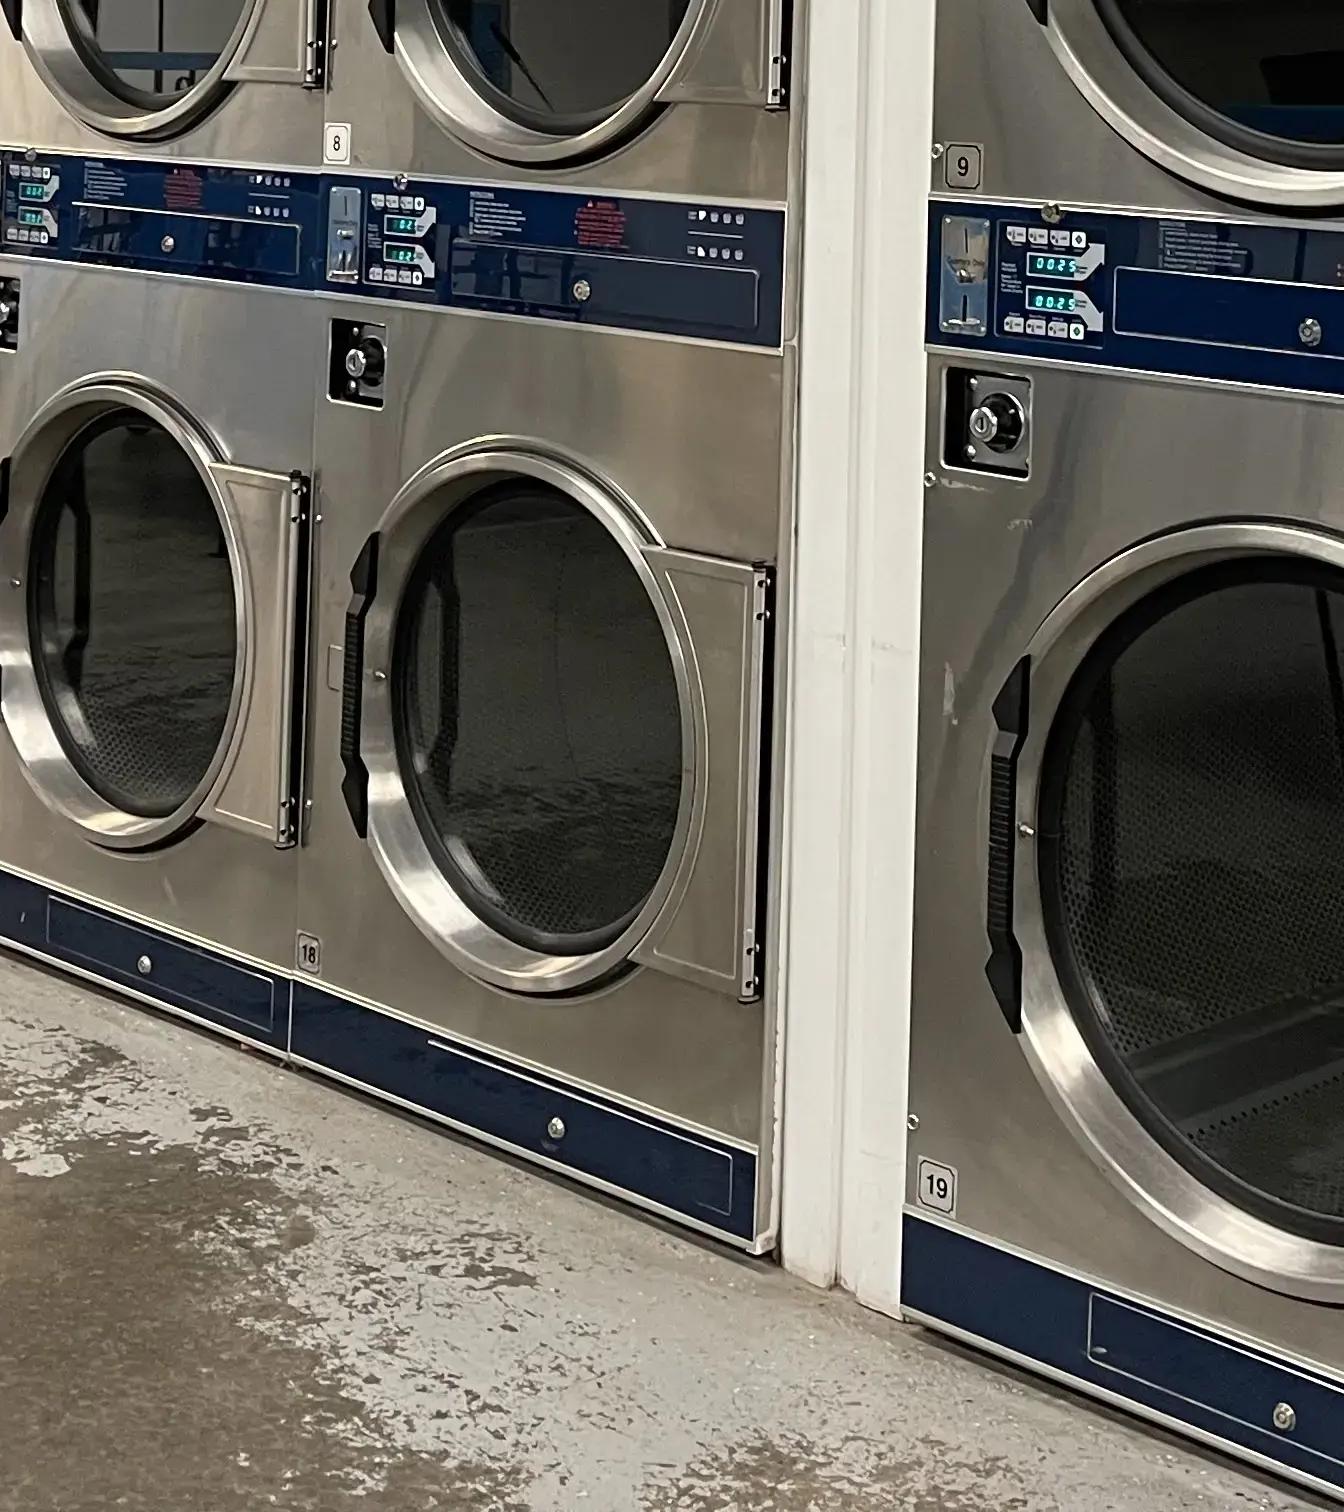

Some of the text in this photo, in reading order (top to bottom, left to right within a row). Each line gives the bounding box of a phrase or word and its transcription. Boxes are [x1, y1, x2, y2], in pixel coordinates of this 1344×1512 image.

[332, 135, 341, 151] 8
[957, 156, 969, 178] 9
[302, 944, 316, 964] 18
[926, 1173, 948, 1199] 19
